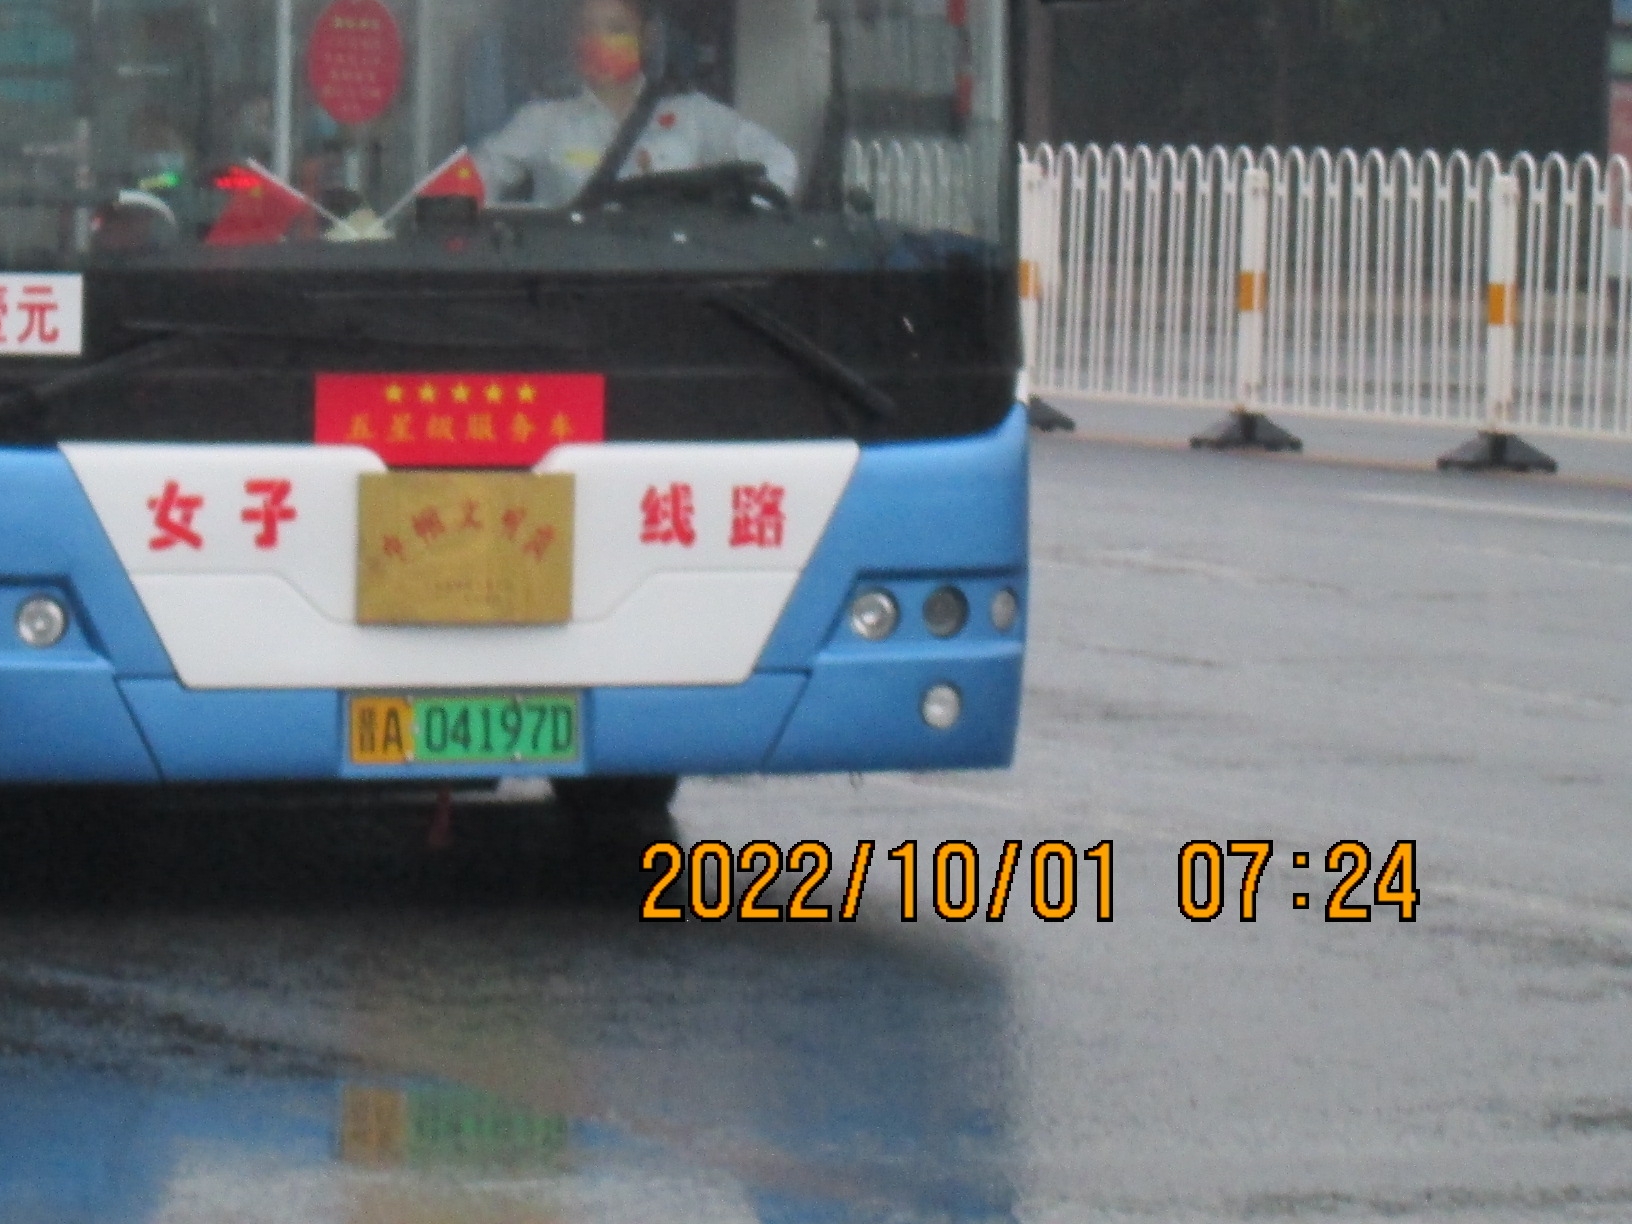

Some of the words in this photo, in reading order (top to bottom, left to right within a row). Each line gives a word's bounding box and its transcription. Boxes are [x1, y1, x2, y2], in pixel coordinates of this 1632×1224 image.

[146, 479, 298, 552] 女子
[639, 484, 786, 550] 线路
[425, 703, 573, 753] 04197D
